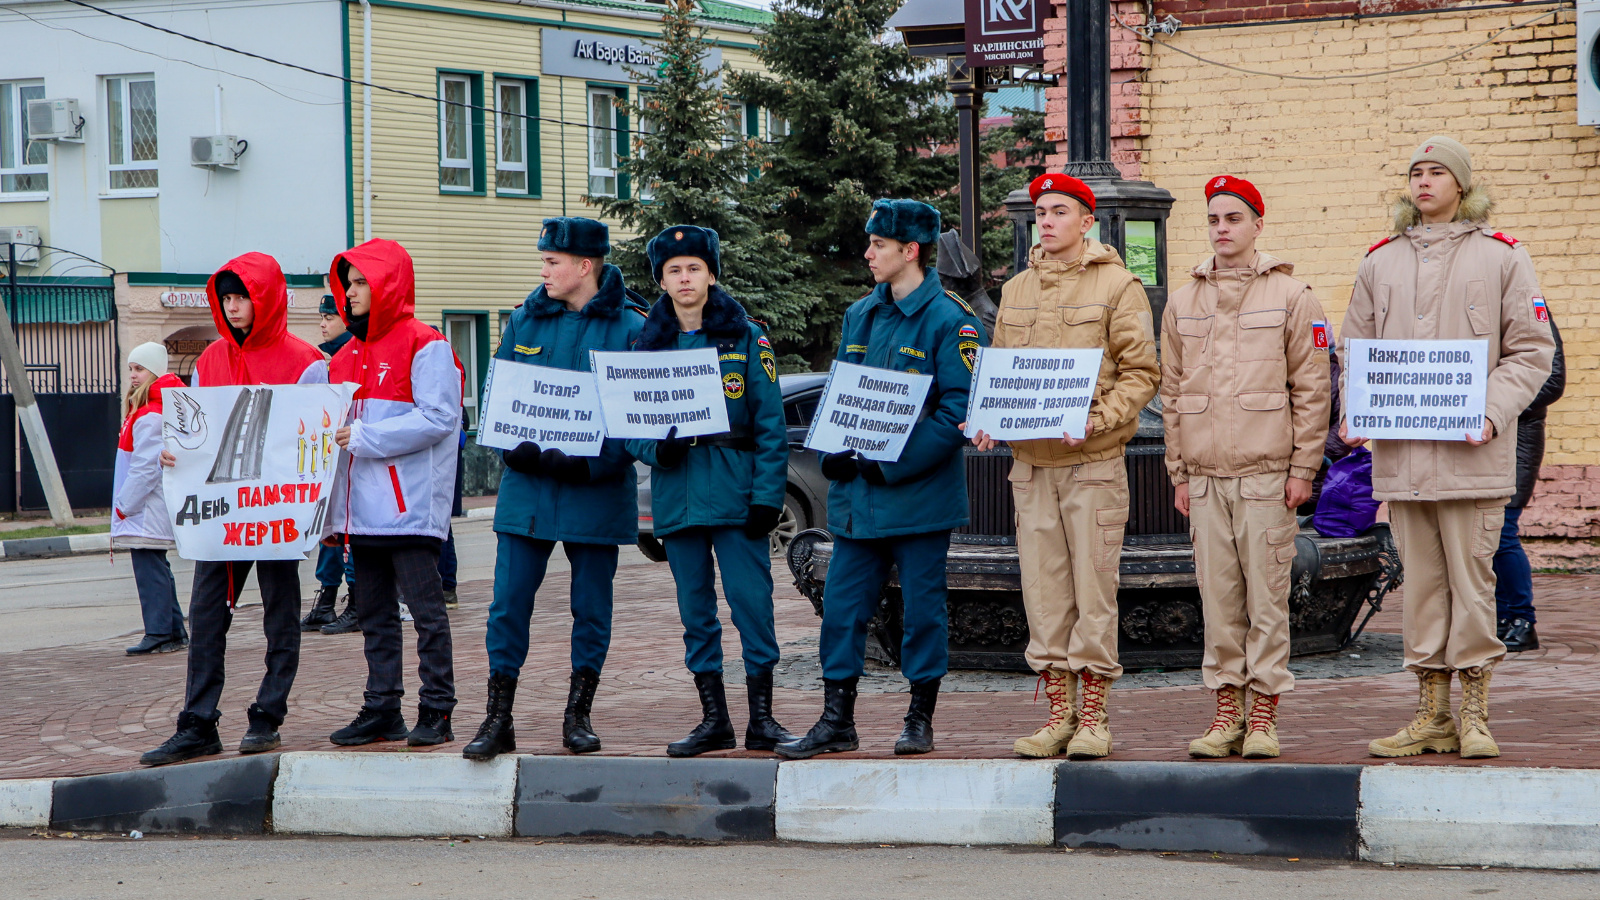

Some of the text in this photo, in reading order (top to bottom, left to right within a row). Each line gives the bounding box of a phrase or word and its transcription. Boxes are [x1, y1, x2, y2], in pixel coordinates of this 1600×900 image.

[575, 39, 657, 65] Ак Барс Банк
[973, 37, 1045, 53] КАРЛИНСКИЙ
[984, 51, 1034, 61] МЯСНОЙ ДОМ
[1012, 355, 1075, 371] Разговор по
[1368, 347, 1473, 365] Каждое слово,
[606, 363, 719, 381] Движение жизнь,
[1367, 371, 1473, 385] написанное за
[533, 379, 581, 399] Устал?
[857, 374, 910, 397] Помните,
[989, 376, 1090, 391] телефону во время
[633, 388, 695, 404] когда оно
[836, 393, 916, 416] каждая буква
[979, 396, 1037, 410] движения
[1043, 396, 1090, 411] разговор
[1369, 393, 1468, 409] рулем, может
[511, 400, 593, 422] Отдохни, ты
[626, 407, 712, 426] по правилам!
[829, 409, 910, 435] ПДД написана
[1000, 414, 1065, 430] со смертью!
[1353, 414, 1482, 431] стать последним!
[493, 422, 601, 443] везде успеешь!
[842, 434, 890, 452] кровью!
[237, 482, 323, 509] ПАМЯТИ
[222, 517, 300, 547] ЖЕРТВ
